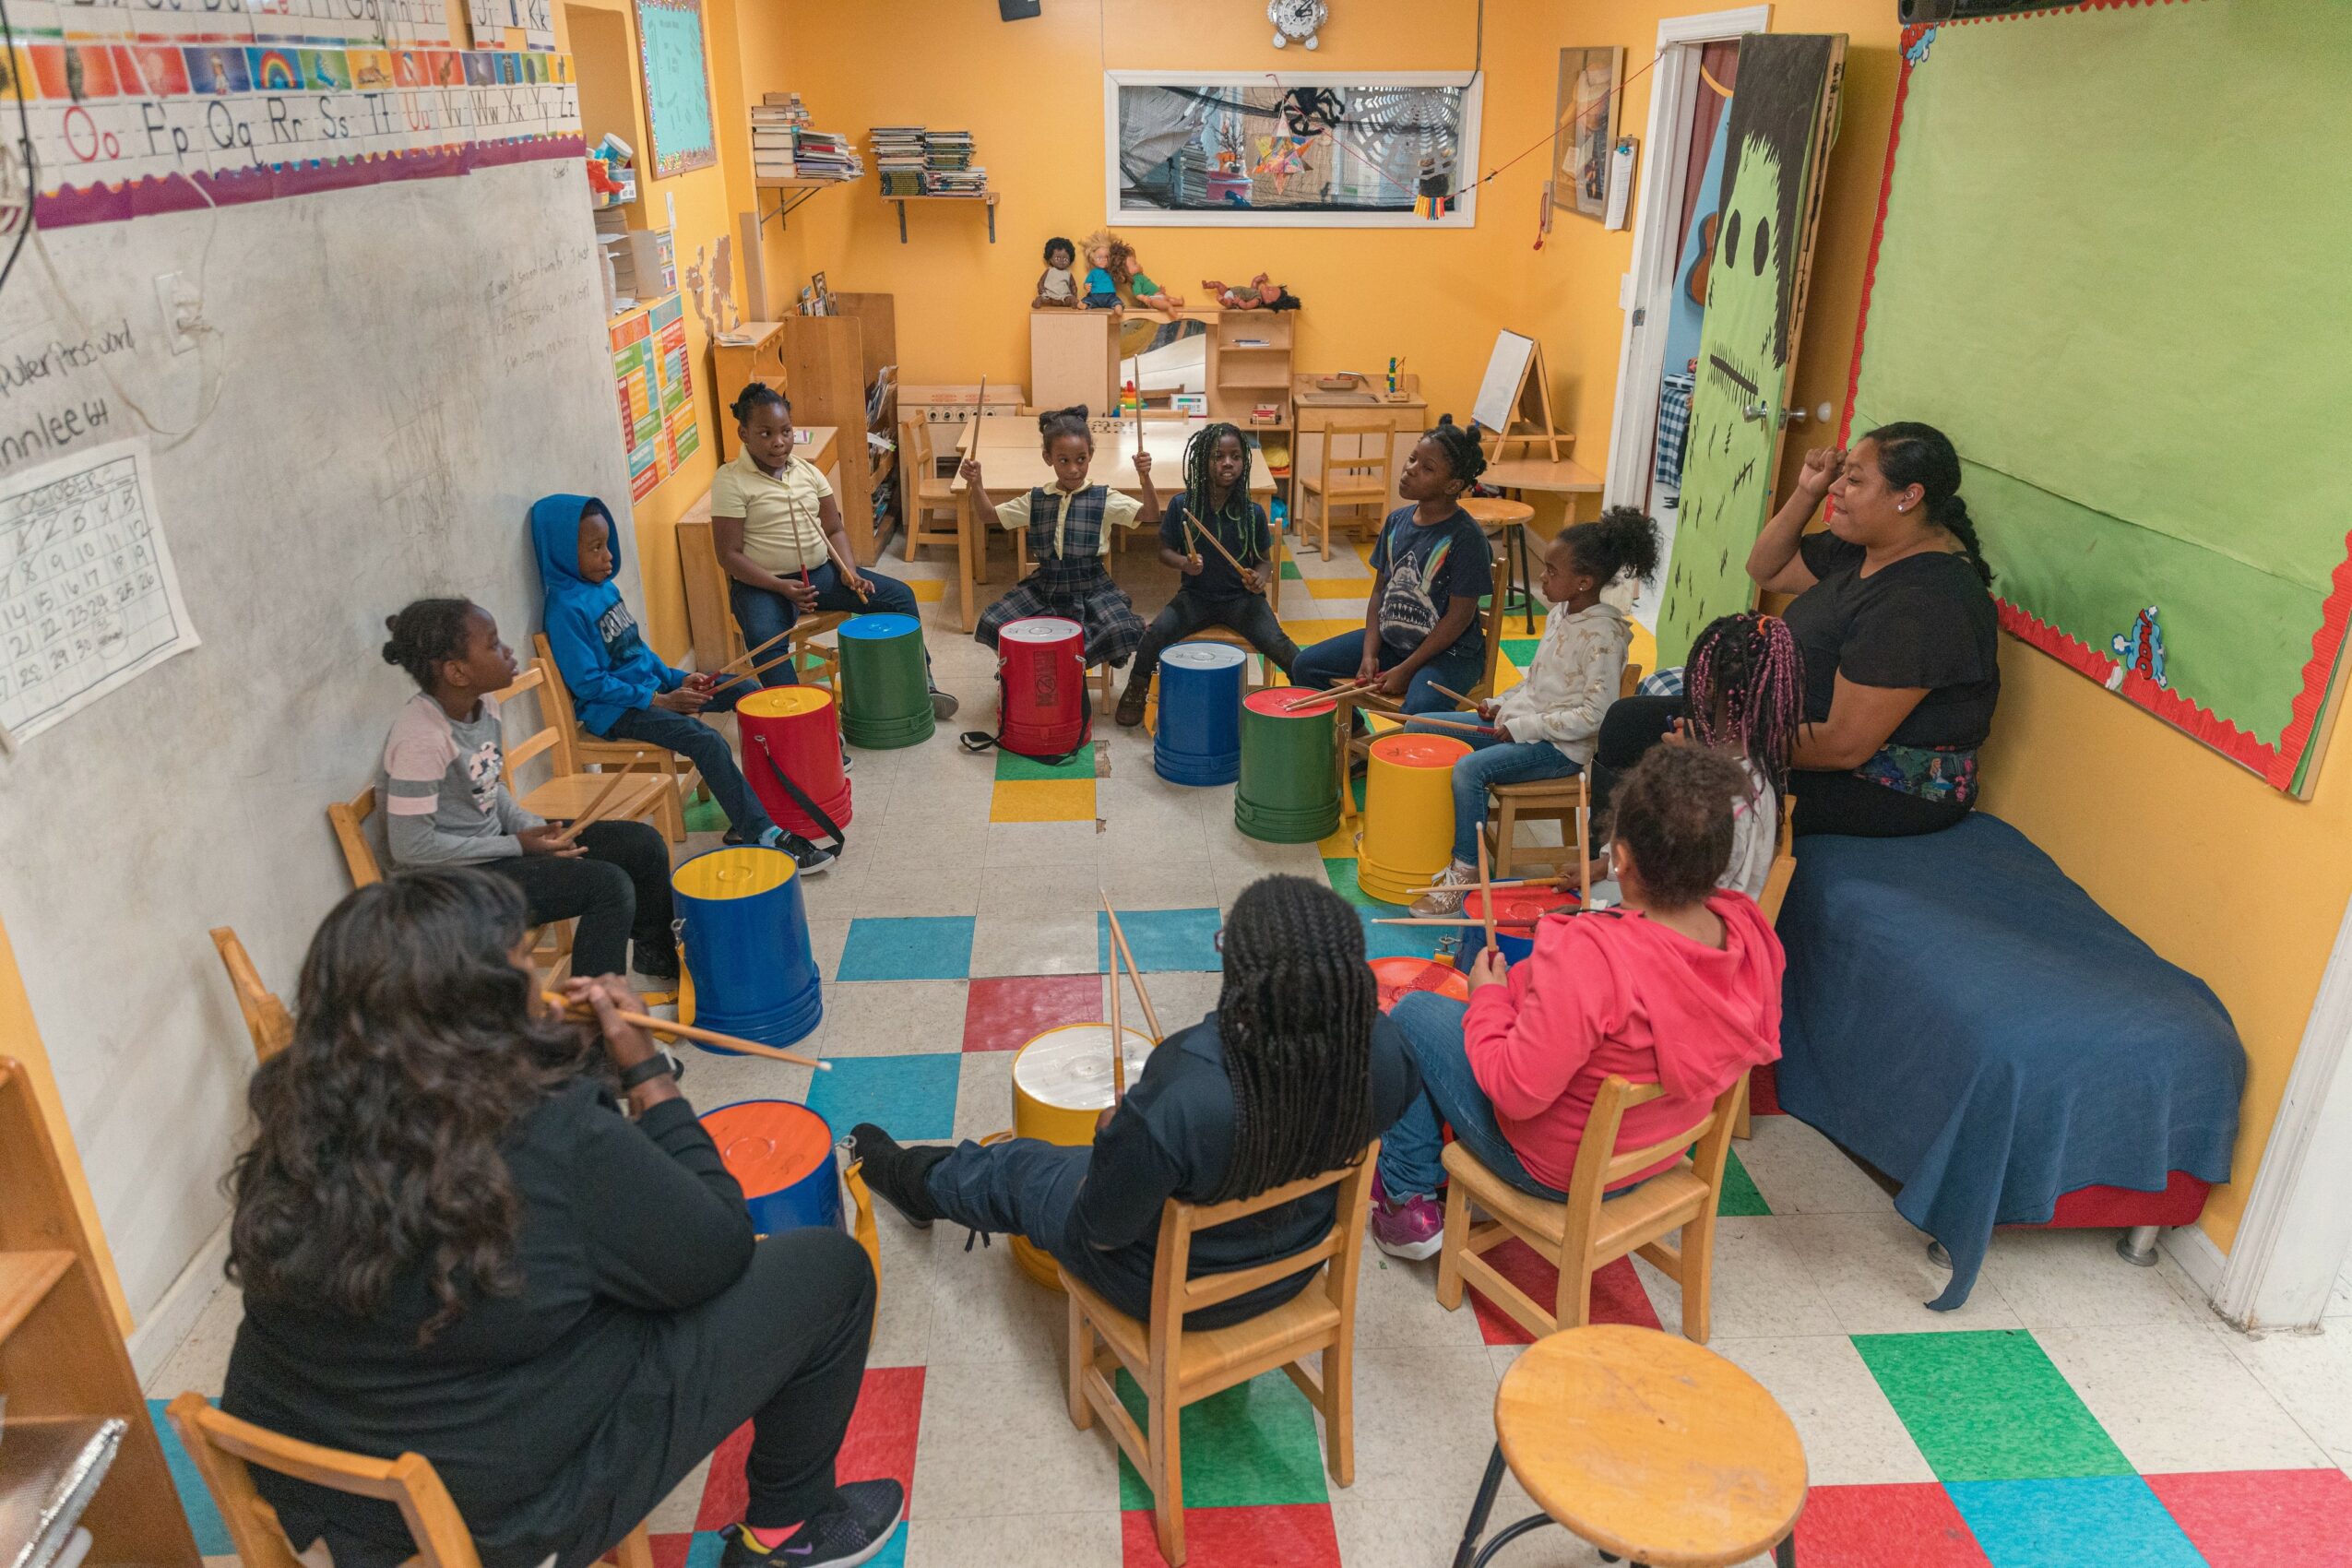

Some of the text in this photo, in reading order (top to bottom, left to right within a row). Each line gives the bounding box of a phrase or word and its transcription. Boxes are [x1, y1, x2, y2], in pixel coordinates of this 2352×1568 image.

[63, 104, 120, 162] Oo
[208, 100, 266, 167] Qq
[267, 96, 303, 143] Rr
[319, 95, 350, 138] Ss
[363, 92, 391, 135] Tt
[404, 92, 431, 131] Uu
[441, 90, 462, 127] Vv
[470, 89, 499, 125] Ww
[504, 89, 526, 122] Xx
[530, 88, 549, 135] Yy
[556, 87, 576, 118] Zz
[18, 471, 103, 515] OCTOBER
[52, 554, 66, 573] 9
[76, 542, 96, 564] 10
[105, 532, 121, 551] 11
[129, 518, 154, 539] 12
[3, 603, 28, 629] 14
[35, 591, 54, 612] 15
[61, 578, 80, 596] 16
[83, 568, 101, 588] 17
[9, 629, 31, 659] 21
[40, 617, 63, 643] 22
[65, 604, 89, 629] 23
[89, 593, 110, 618] 24
[138, 571, 155, 591] 26
[49, 647, 70, 671] 29
[76, 636, 92, 660] 30
